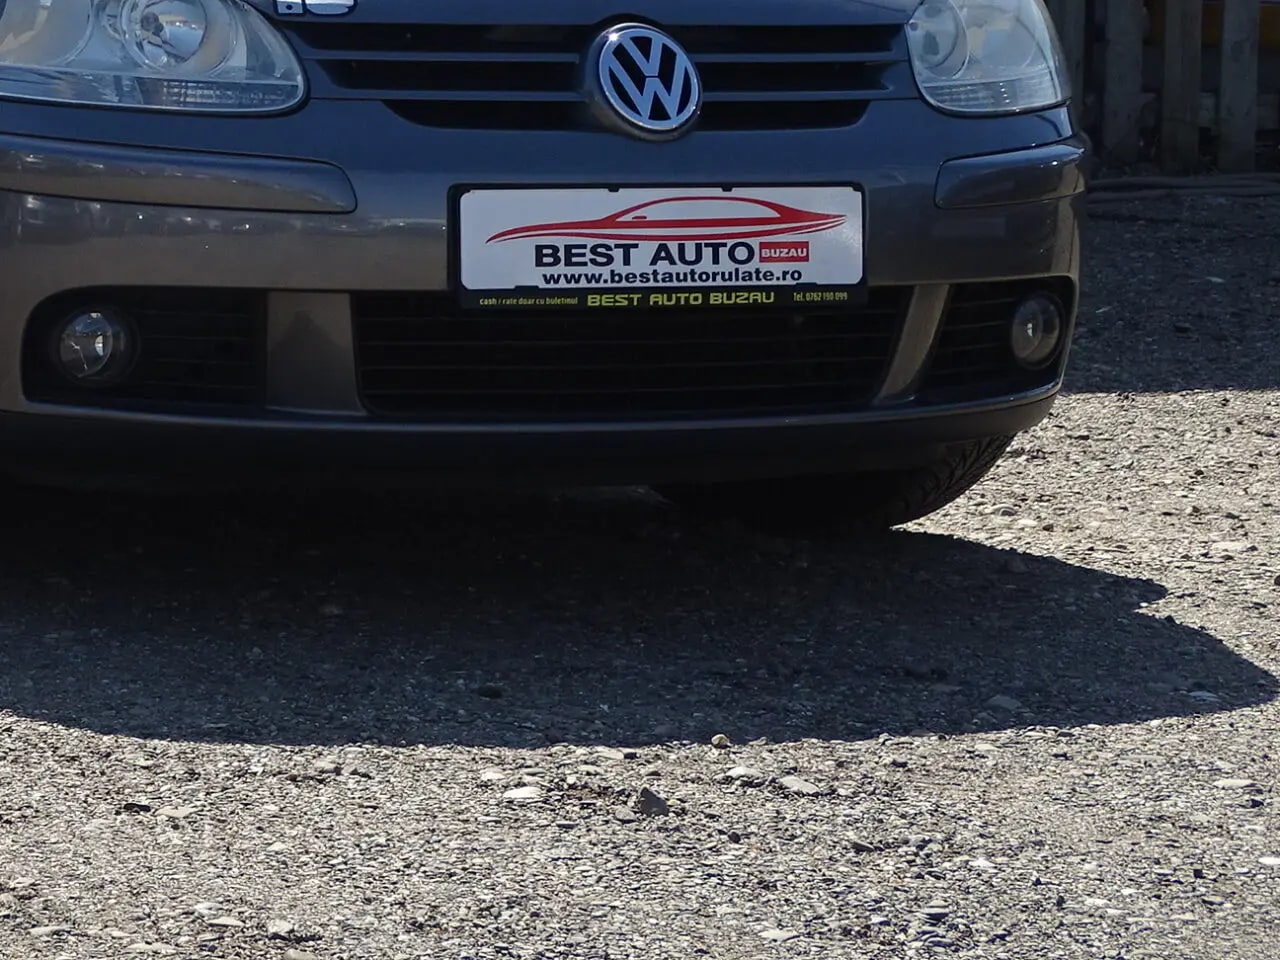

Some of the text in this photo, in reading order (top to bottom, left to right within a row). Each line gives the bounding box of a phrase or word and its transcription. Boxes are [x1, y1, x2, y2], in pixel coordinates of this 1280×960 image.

[535, 241, 808, 268] BEST AUTO BUZAU
[542, 267, 803, 285] www.bestautorulate.ro
[587, 294, 642, 306] BEST
[650, 293, 702, 306] AUTO
[709, 292, 775, 305] BUZAU
